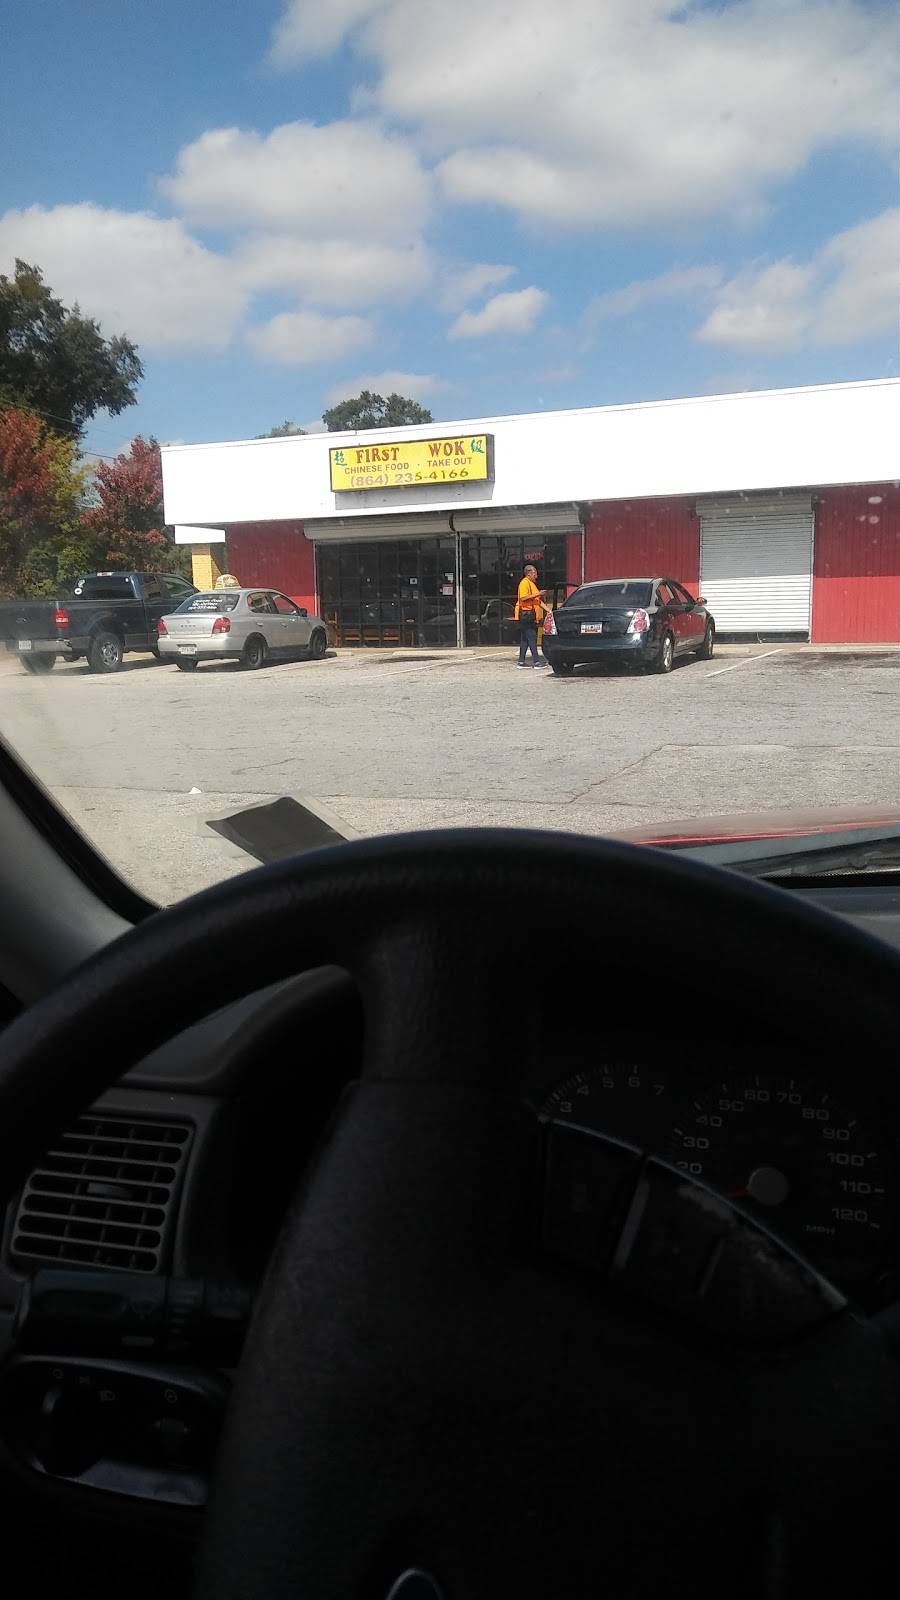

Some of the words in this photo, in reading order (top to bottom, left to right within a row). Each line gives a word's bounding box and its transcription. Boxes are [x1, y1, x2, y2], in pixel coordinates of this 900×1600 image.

[356, 447, 400, 463] FIRST
[428, 441, 466, 457] WOK
[345, 465, 382, 474] CHINESE
[386, 462, 409, 471] FOOD
[427, 459, 451, 467] TAKE
[454, 457, 472, 465] OUT
[351, 473, 388, 487] (864)
[394, 468, 469, 483] 235-4166
[602, 1077, 614, 1088] 5
[628, 1076, 640, 1088] 6
[577, 1085, 589, 1096] 4
[652, 1084, 665, 1096] 7
[744, 1089, 770, 1101] 60
[776, 1092, 802, 1105] 70
[560, 1101, 572, 1113] 3
[719, 1099, 745, 1112] 50
[695, 1115, 723, 1127] 40
[801, 1108, 830, 1121] 80
[822, 1127, 850, 1141] 90
[682, 1136, 710, 1149] 30
[827, 1152, 865, 1166] 100
[840, 1180, 872, 1194] 110
[832, 1207, 868, 1222] 120
